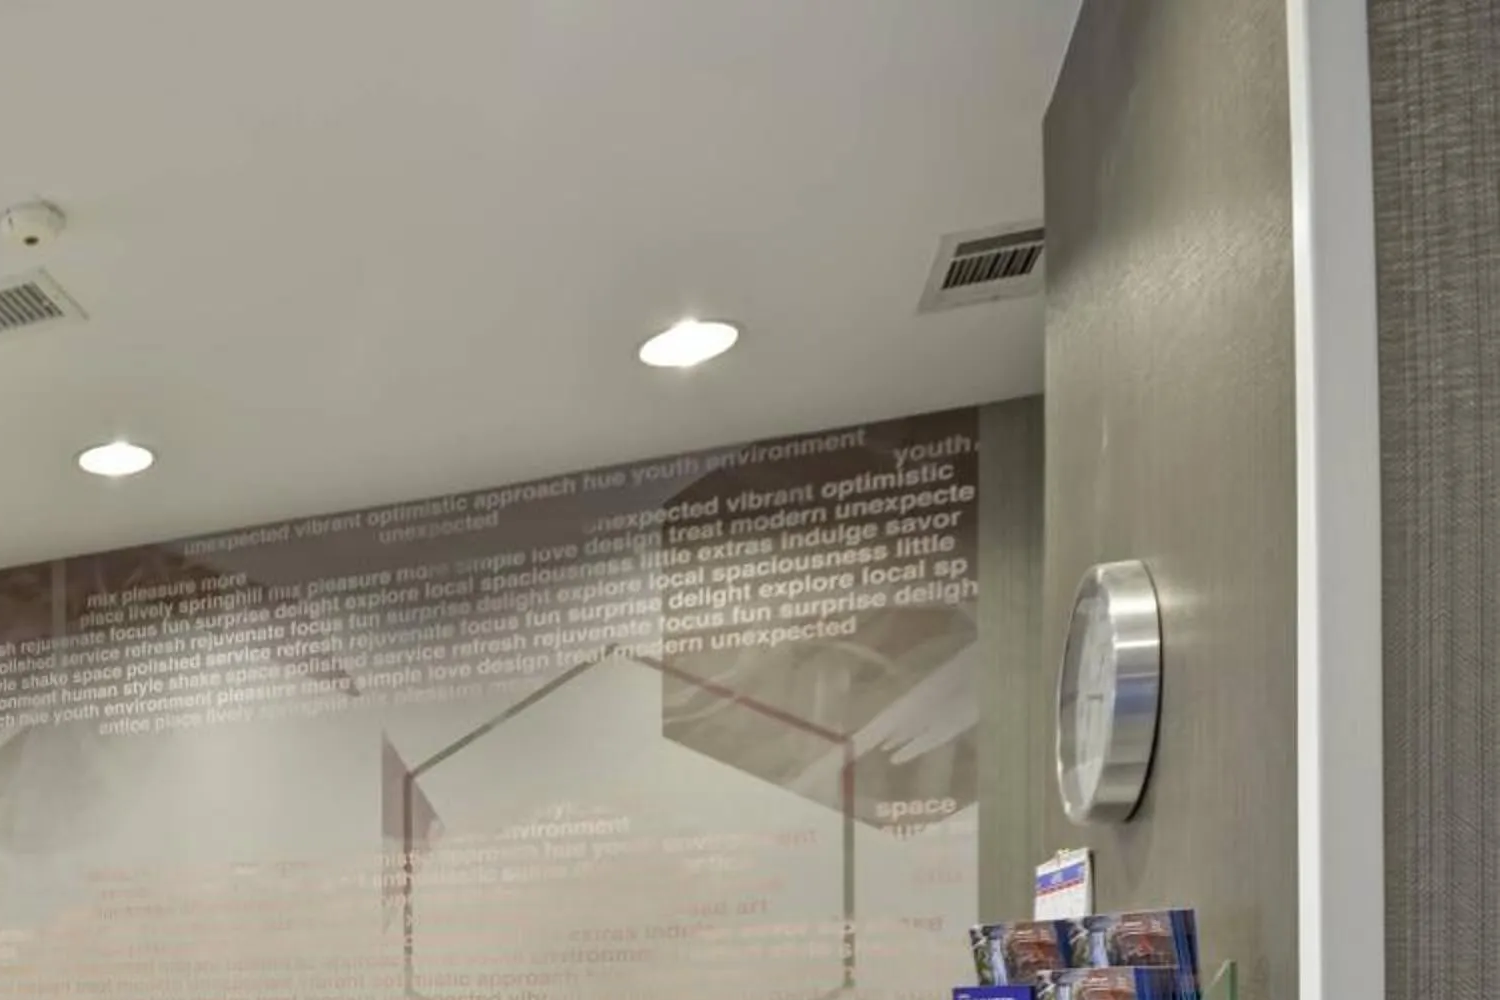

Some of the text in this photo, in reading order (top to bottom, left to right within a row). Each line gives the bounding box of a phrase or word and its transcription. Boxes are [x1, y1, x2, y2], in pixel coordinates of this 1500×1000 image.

[294, 511, 360, 537] vibrant
[366, 495, 466, 527] optimistic
[473, 476, 575, 509] approach
[583, 471, 623, 490] hue
[630, 455, 699, 486] youth
[703, 428, 865, 471] environment
[726, 483, 814, 512] vibrant
[821, 464, 953, 500] optimistic
[893, 433, 971, 467] youth
[21, 630, 104, 655] rejuvenate
[109, 624, 157, 642] focus
[162, 619, 189, 635] fun
[195, 608, 268, 630] surprise
[275, 595, 339, 619] delight
[345, 588, 418, 610] explore
[424, 576, 473, 599] local
[481, 558, 632, 593] spaciousness
[641, 548, 691, 569] little
[697, 538, 772, 561] extras
[781, 524, 876, 550] indulge
[885, 512, 961, 536] savor
[62, 647, 119, 666] service
[125, 636, 184, 658] refresh
[191, 624, 284, 651] rejuvenate
[290, 618, 342, 637] focus
[349, 613, 379, 629] fun
[387, 601, 470, 624] surprise
[476, 586, 551, 612] delight
[557, 578, 640, 602] explore
[649, 566, 703, 589] local
[712, 545, 887, 583] spaciousness
[897, 534, 954, 557] little
[80, 610, 123, 630] place
[128, 601, 173, 620] lively
[178, 586, 262, 615] springhill
[307, 571, 391, 598] pleasure
[532, 544, 577, 563] love
[584, 532, 660, 555] design
[669, 519, 722, 543] treat
[730, 508, 826, 534] modern
[834, 484, 975, 520] unexpecte
[87, 573, 246, 608] mix pleasure more
[22, 671, 67, 690] shake
[72, 666, 121, 685] space
[127, 653, 199, 680] polished
[206, 646, 270, 667] service
[276, 634, 342, 658] refresh
[349, 621, 453, 650] rejuvenate
[460, 615, 518, 635] focus
[526, 609, 559, 626] fun
[568, 597, 662, 621] surprise
[669, 581, 751, 609] delight
[758, 572, 854, 597] explore
[861, 559, 924, 584] local
[934, 557, 967, 577] sp
[53, 703, 99, 726] youth
[104, 690, 211, 717] environment
[303, 677, 350, 694] more
[357, 667, 422, 688] simple
[428, 663, 471, 680] love
[477, 654, 549, 675] design
[710, 615, 856, 649] unexpected
[61, 685, 117, 703] human
[123, 678, 163, 697] style
[168, 670, 221, 690] shake
[226, 665, 279, 686] space
[285, 651, 366, 680] polished
[373, 645, 445, 666] service
[452, 632, 526, 657] refresh
[533, 618, 651, 648] rejuvenate
[660, 611, 723, 632] focus
[731, 605, 770, 623] fun
[779, 591, 885, 618] surprise
[875, 799, 957, 821] space
